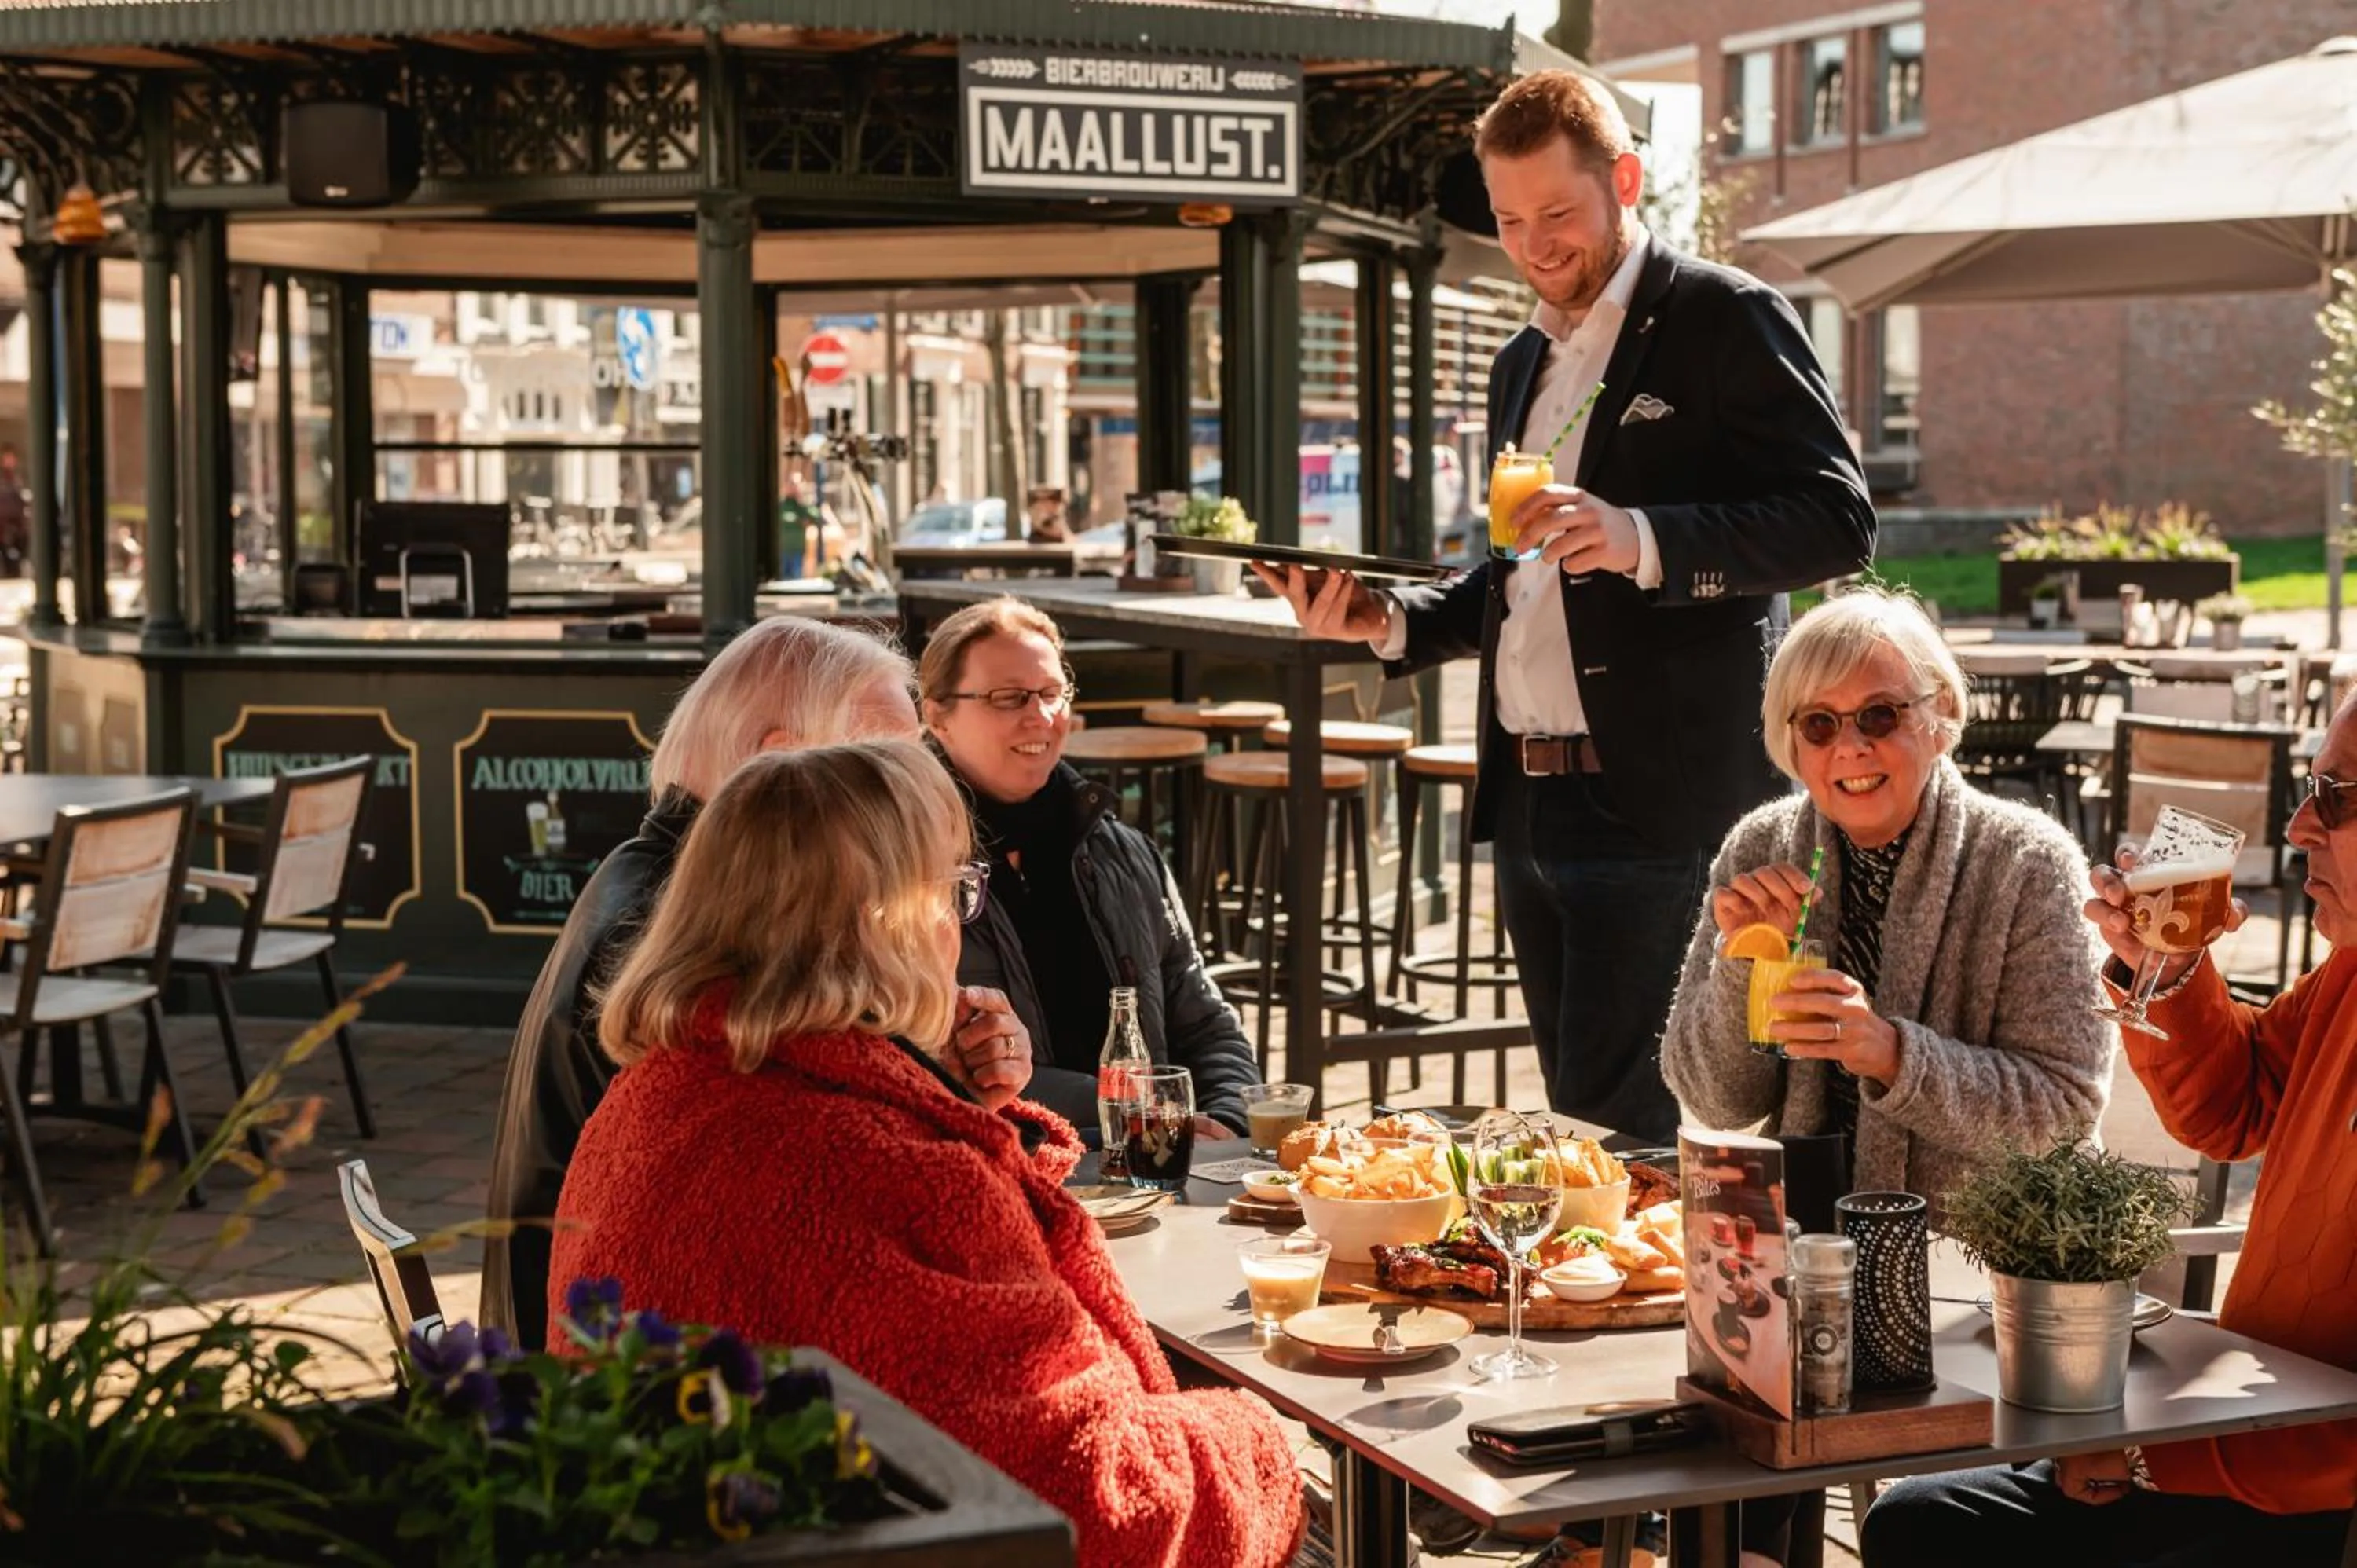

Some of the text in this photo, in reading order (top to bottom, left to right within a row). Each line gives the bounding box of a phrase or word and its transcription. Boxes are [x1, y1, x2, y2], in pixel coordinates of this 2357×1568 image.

[1044, 57, 1226, 92] BIERBROUWERIJ
[985, 106, 1281, 179] MAALLUST.
[520, 870, 575, 903] BIER
